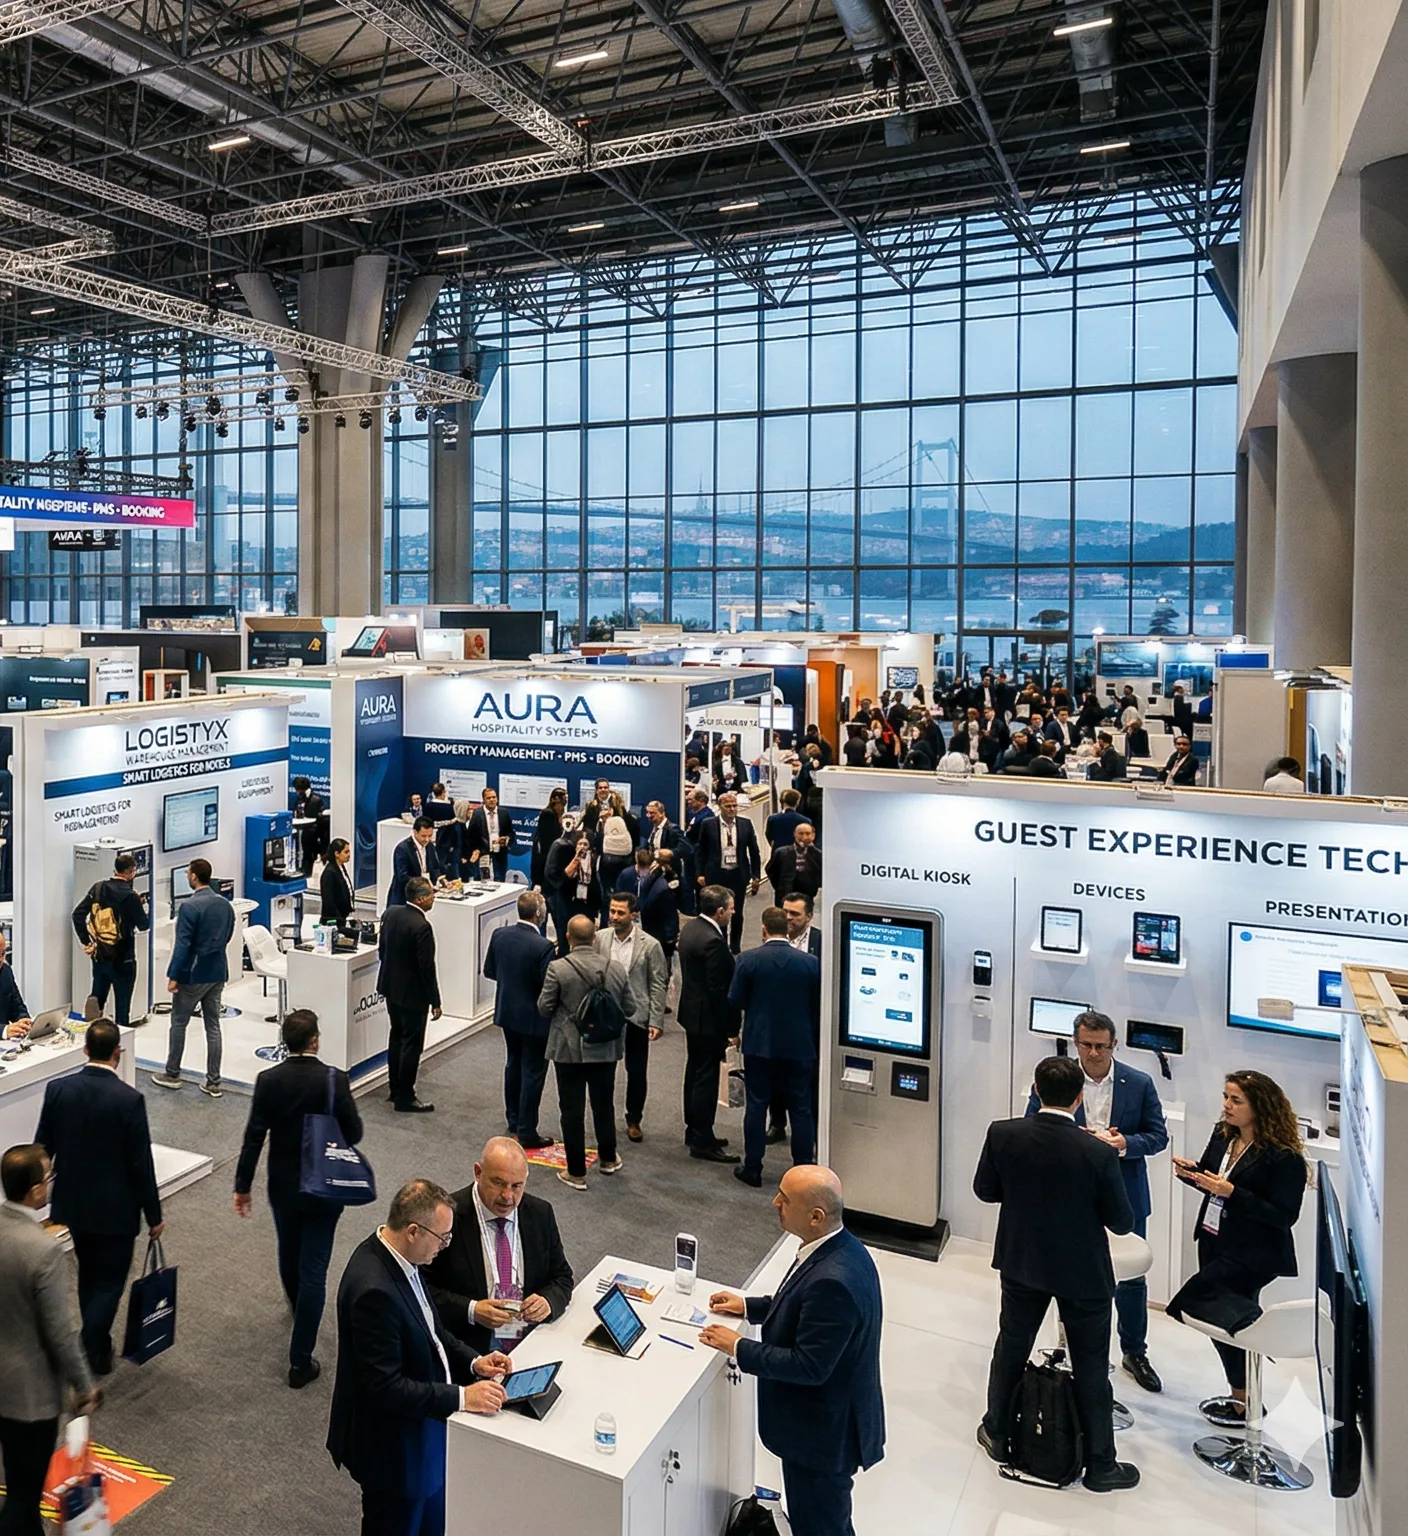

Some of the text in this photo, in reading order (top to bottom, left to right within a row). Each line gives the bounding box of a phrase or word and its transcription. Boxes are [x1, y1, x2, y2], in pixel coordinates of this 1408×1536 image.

[121, 504, 165, 519] BOOKING
[361, 694, 397, 717] AURA
[473, 692, 597, 725] AURA
[125, 718, 231, 752] LOGISTYX
[471, 723, 599, 739] HOSPITALITY SYSTEMS
[424, 742, 478, 757] PROPERTY
[479, 746, 554, 761] MANAGEMENT
[564, 752, 587, 764] PMS
[596, 754, 650, 767] BOOKING
[974, 818, 1079, 849] GUEST
[1090, 828, 1308, 868] EXPERIENCE
[860, 862, 971, 886] DIGITAL KIOSK
[1072, 882, 1146, 902] DEVICES
[1265, 900, 1408, 927] PRESENTATIO
